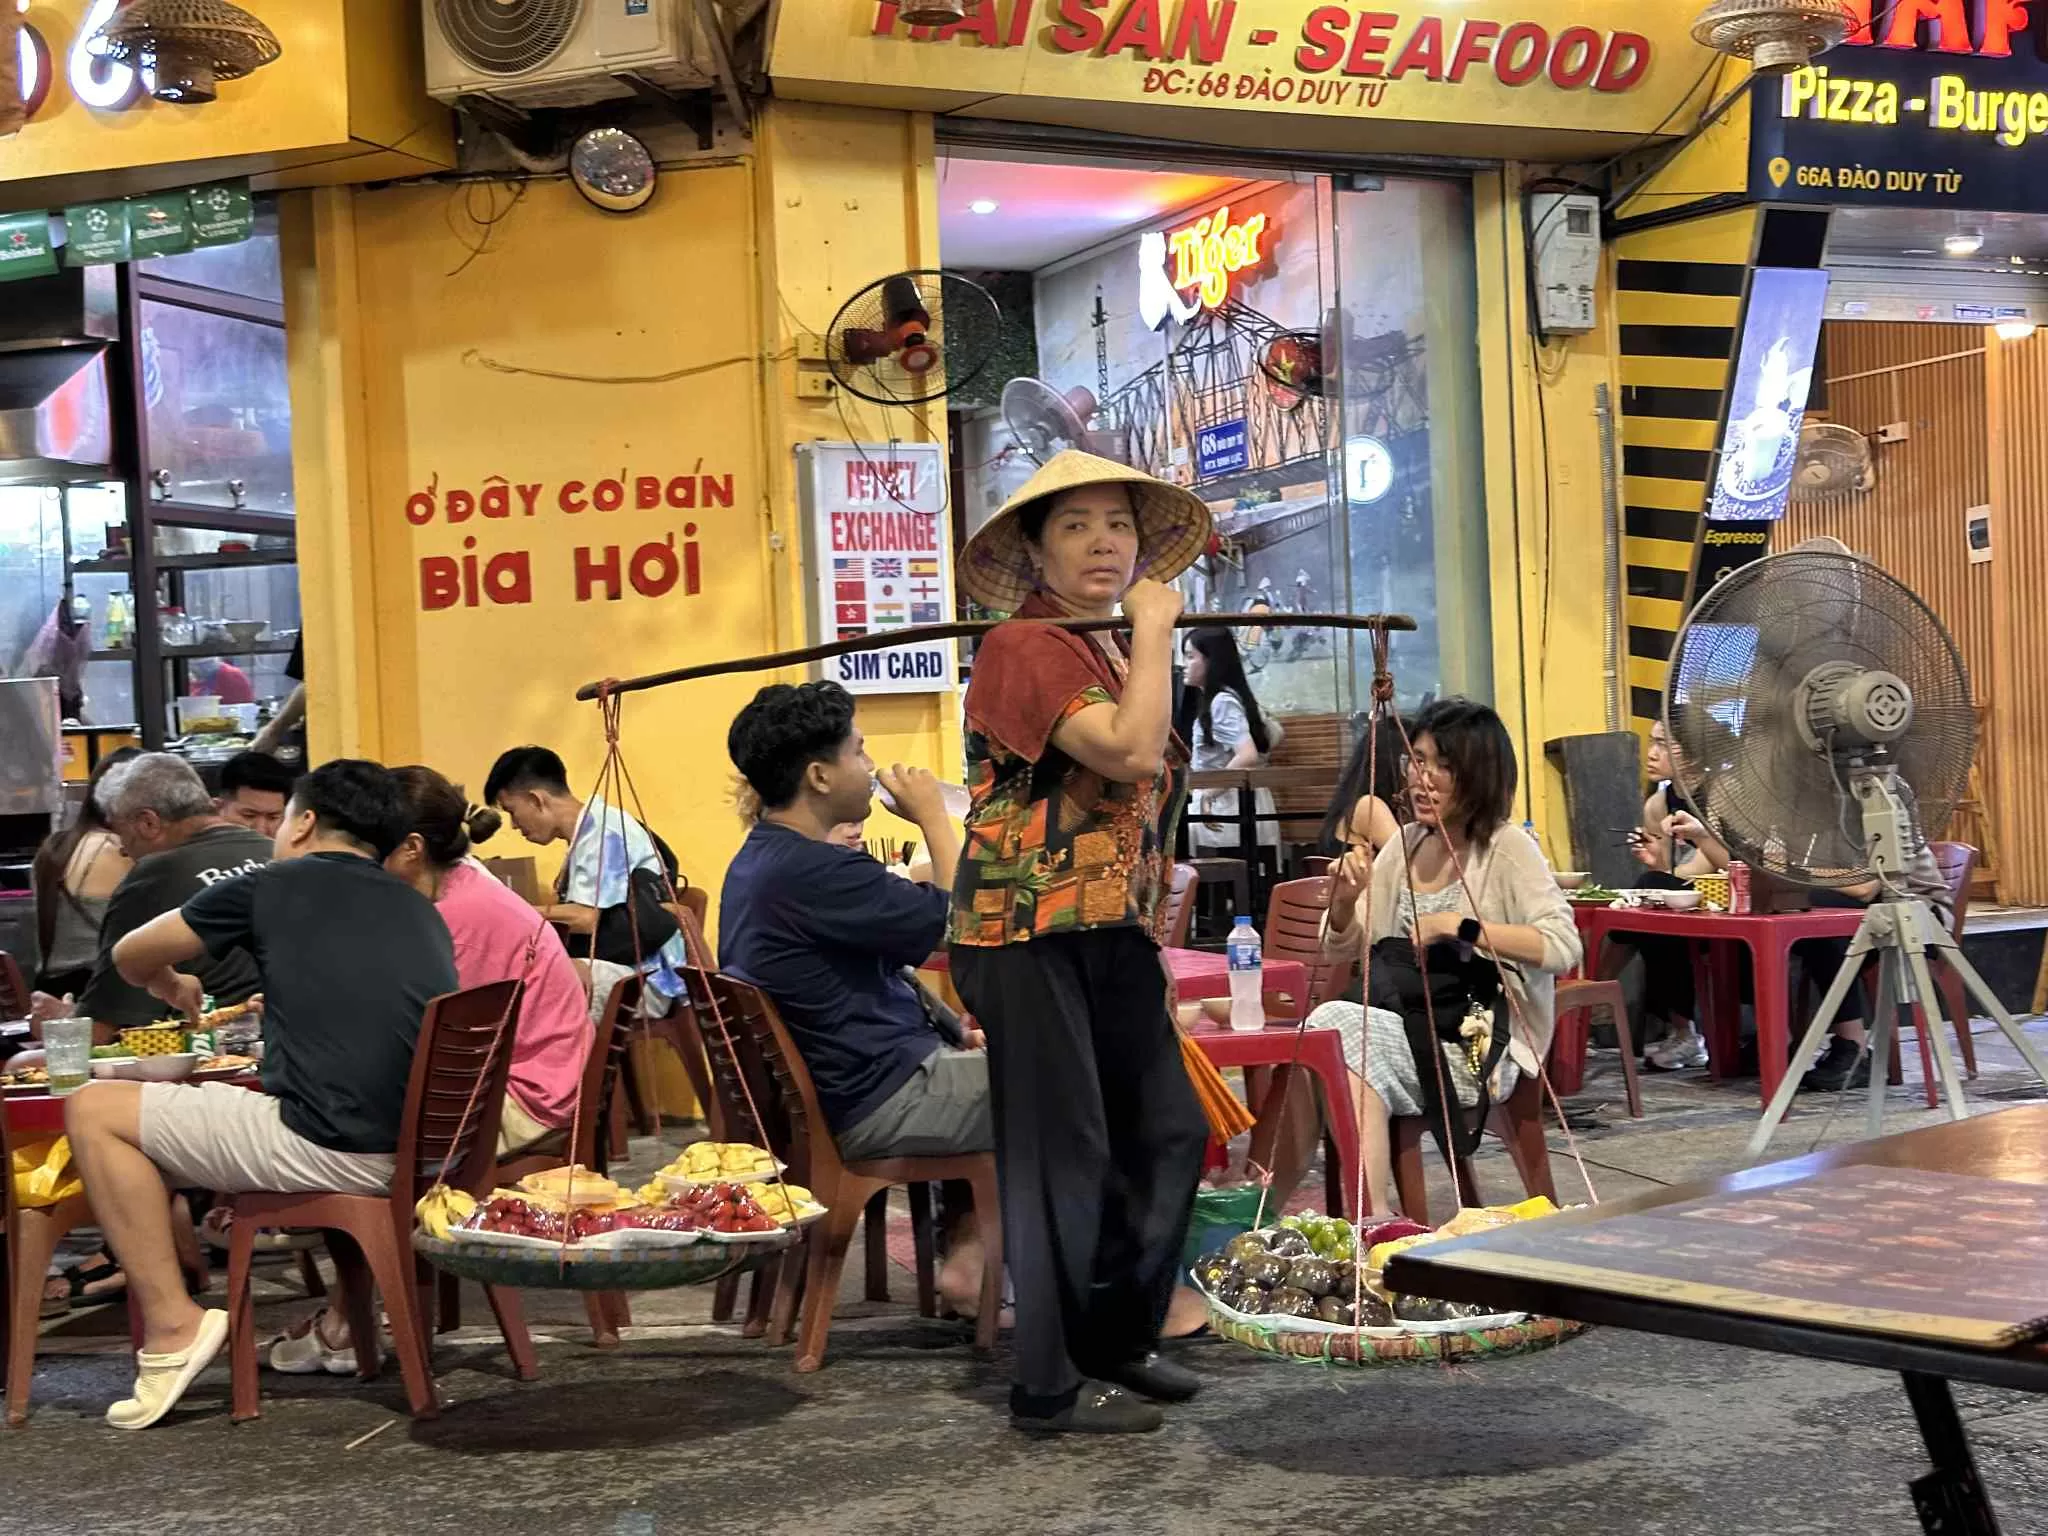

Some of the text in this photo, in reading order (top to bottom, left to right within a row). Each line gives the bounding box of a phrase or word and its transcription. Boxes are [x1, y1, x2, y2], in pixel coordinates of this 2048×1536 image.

[1295, 6, 1651, 92] SEAFOOD
[1235, 67, 1294, 101] ĐÀO
[1297, 79, 1350, 106] DUY
[1786, 65, 1898, 124] Pizza
[1796, 163, 1963, 193] 66A ĐÀO DUY TỪ
[1169, 206, 1265, 308] Tiger
[831, 511, 938, 552] EXCHANGE
[1704, 529, 1766, 547] Espresso
[839, 651, 943, 681] SIM CARD
